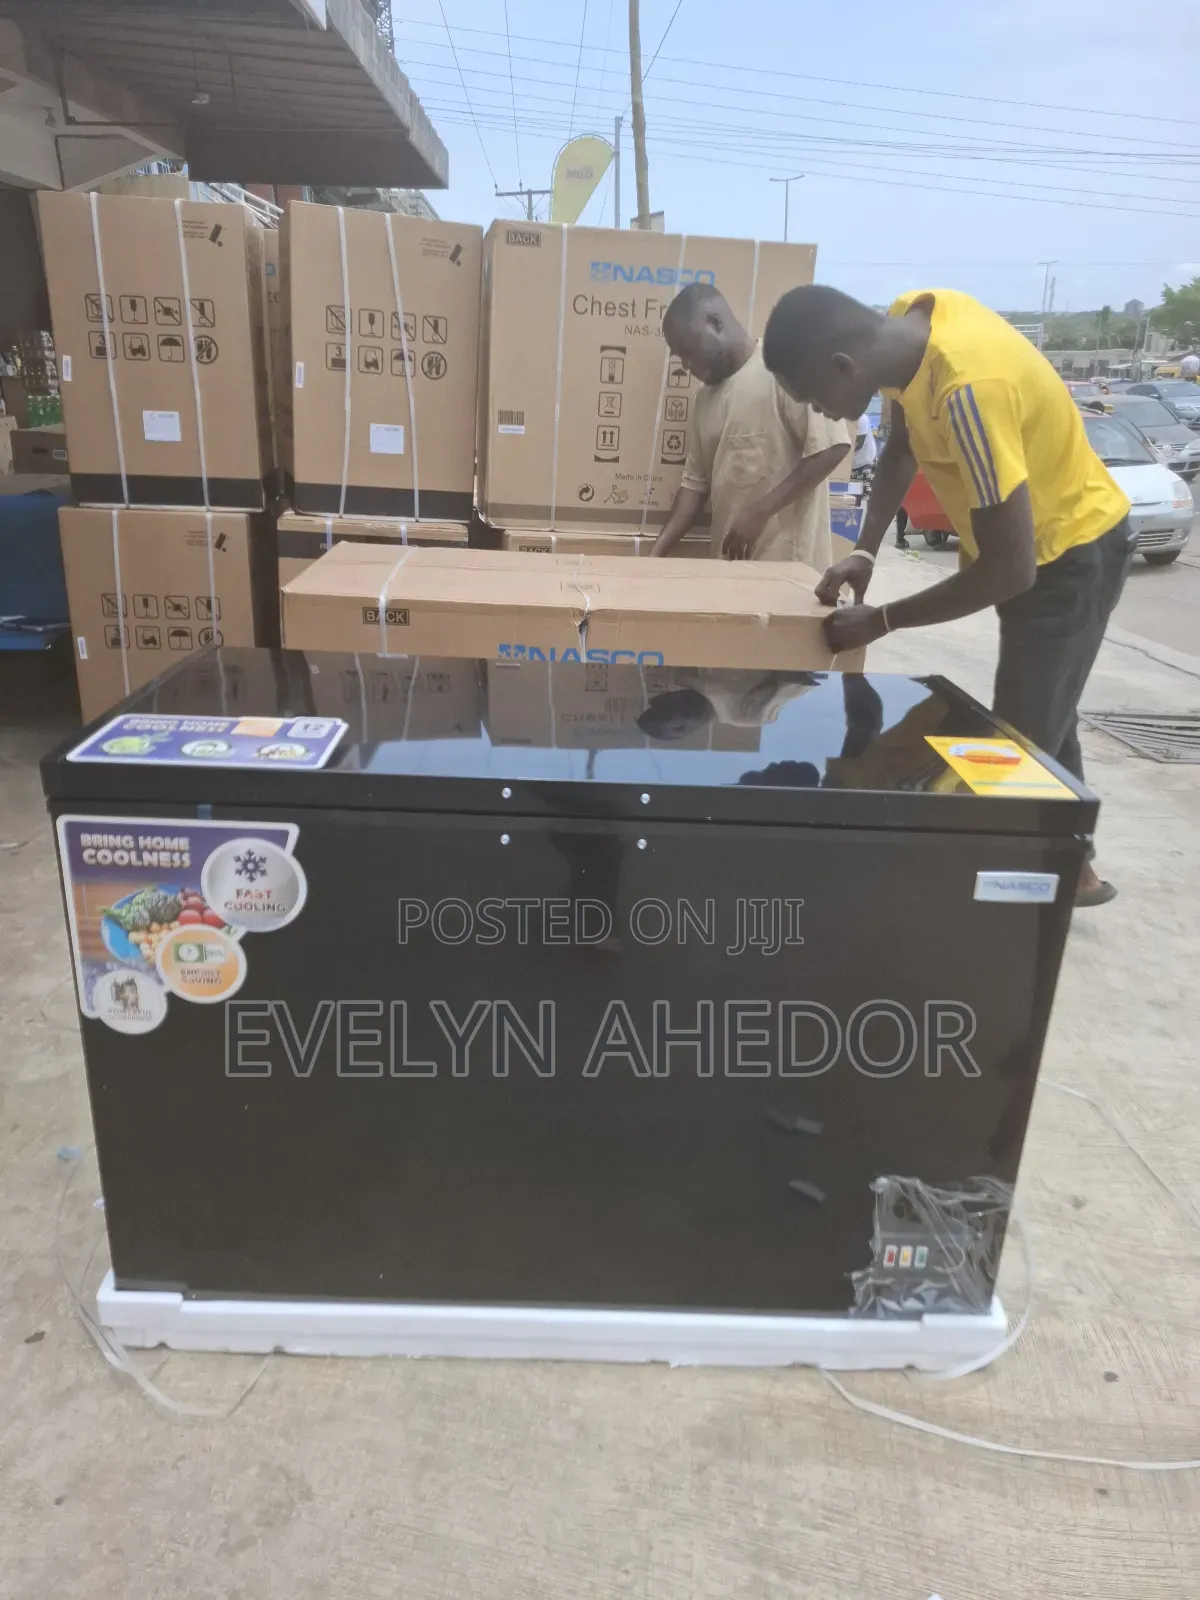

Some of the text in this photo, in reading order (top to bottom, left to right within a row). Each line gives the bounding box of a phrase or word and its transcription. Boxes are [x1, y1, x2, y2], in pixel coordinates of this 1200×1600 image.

[508, 231, 538, 245] BACK
[613, 263, 716, 288] NASCO
[572, 294, 637, 318] Chest
[615, 472, 634, 481] Made
[80, 833, 189, 852] BRING HOME
[82, 848, 191, 868] COOLNESS
[993, 880, 1050, 892] NASCO
[236, 888, 273, 900] FAST
[224, 900, 287, 913] COOLING
